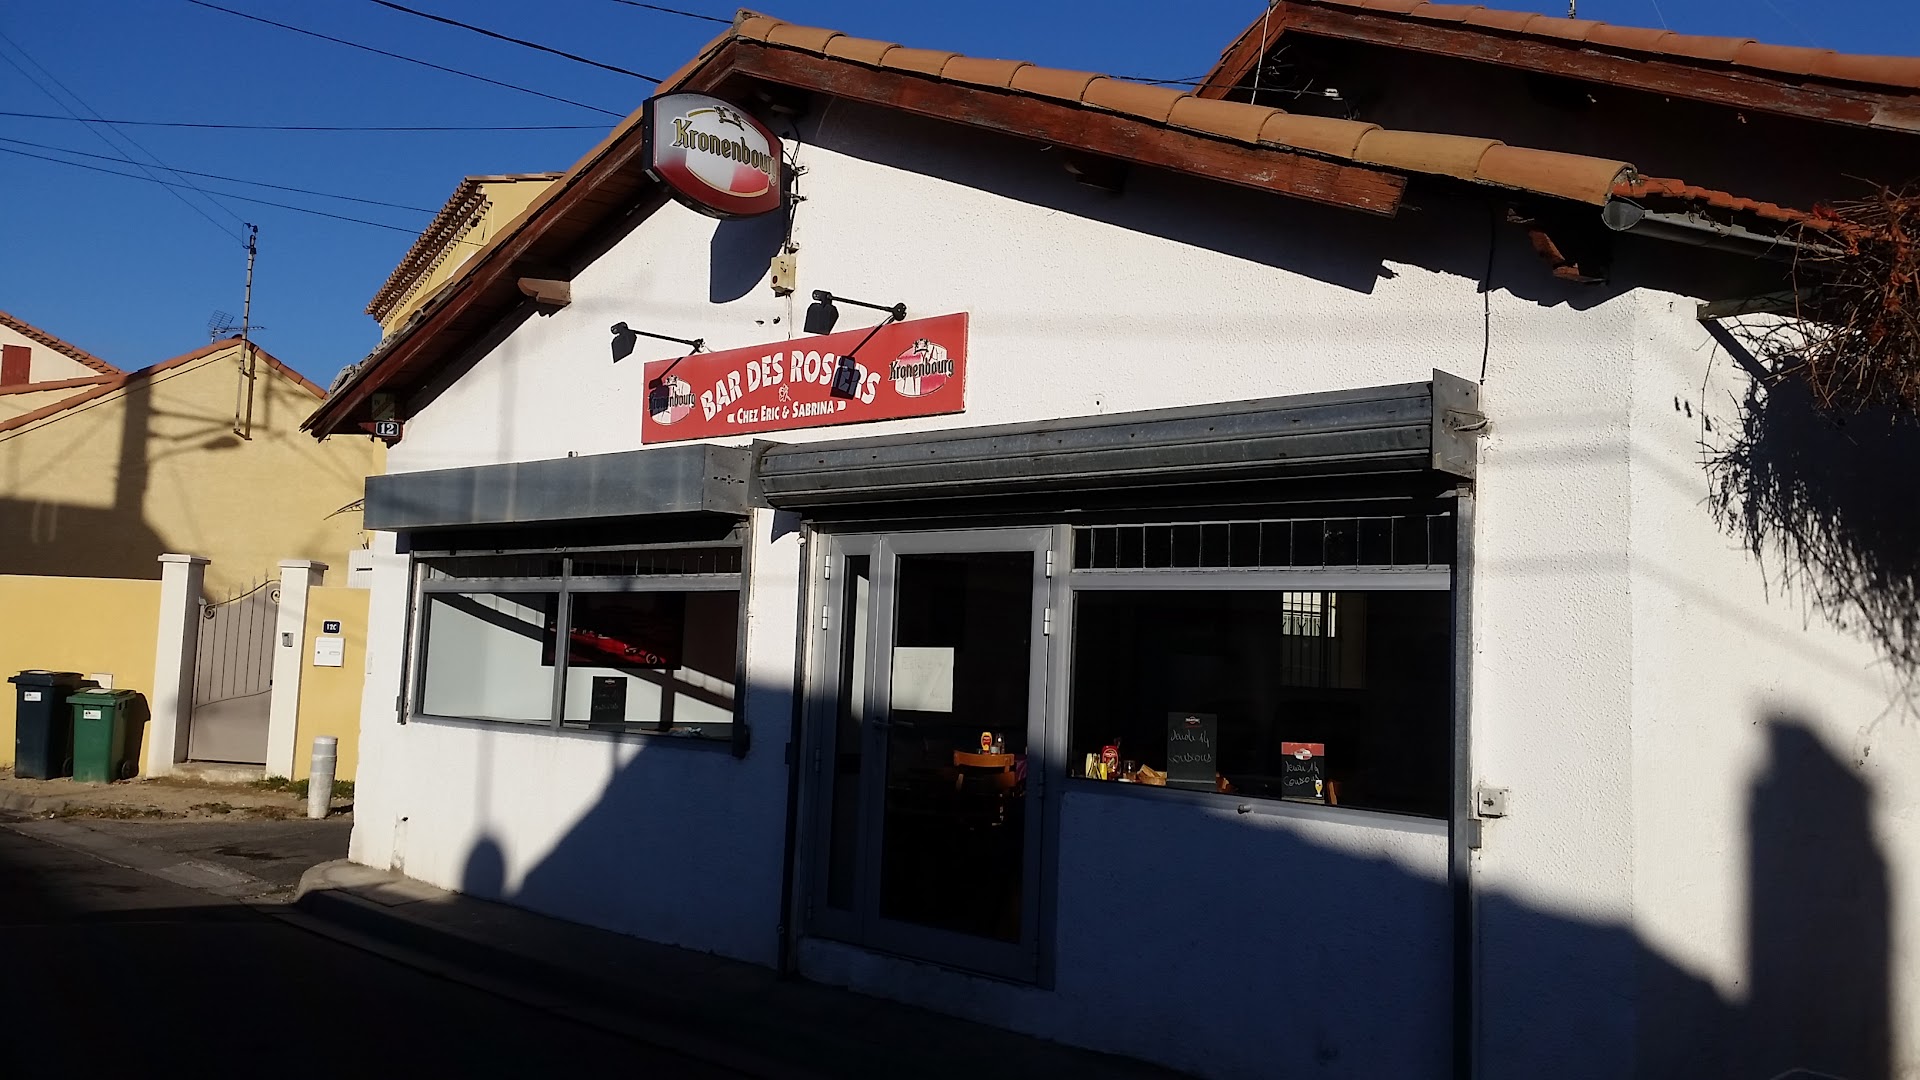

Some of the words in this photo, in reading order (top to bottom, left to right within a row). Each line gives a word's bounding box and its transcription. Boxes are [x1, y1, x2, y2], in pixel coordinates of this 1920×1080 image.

[670, 115, 778, 187] Kronenbourg
[889, 356, 955, 380] Kronenbourg
[700, 370, 743, 422] BAR
[746, 352, 784, 393] DES
[790, 350, 881, 405] ROSIERS
[781, 405, 790, 419] &
[380, 423, 395, 434] 12
